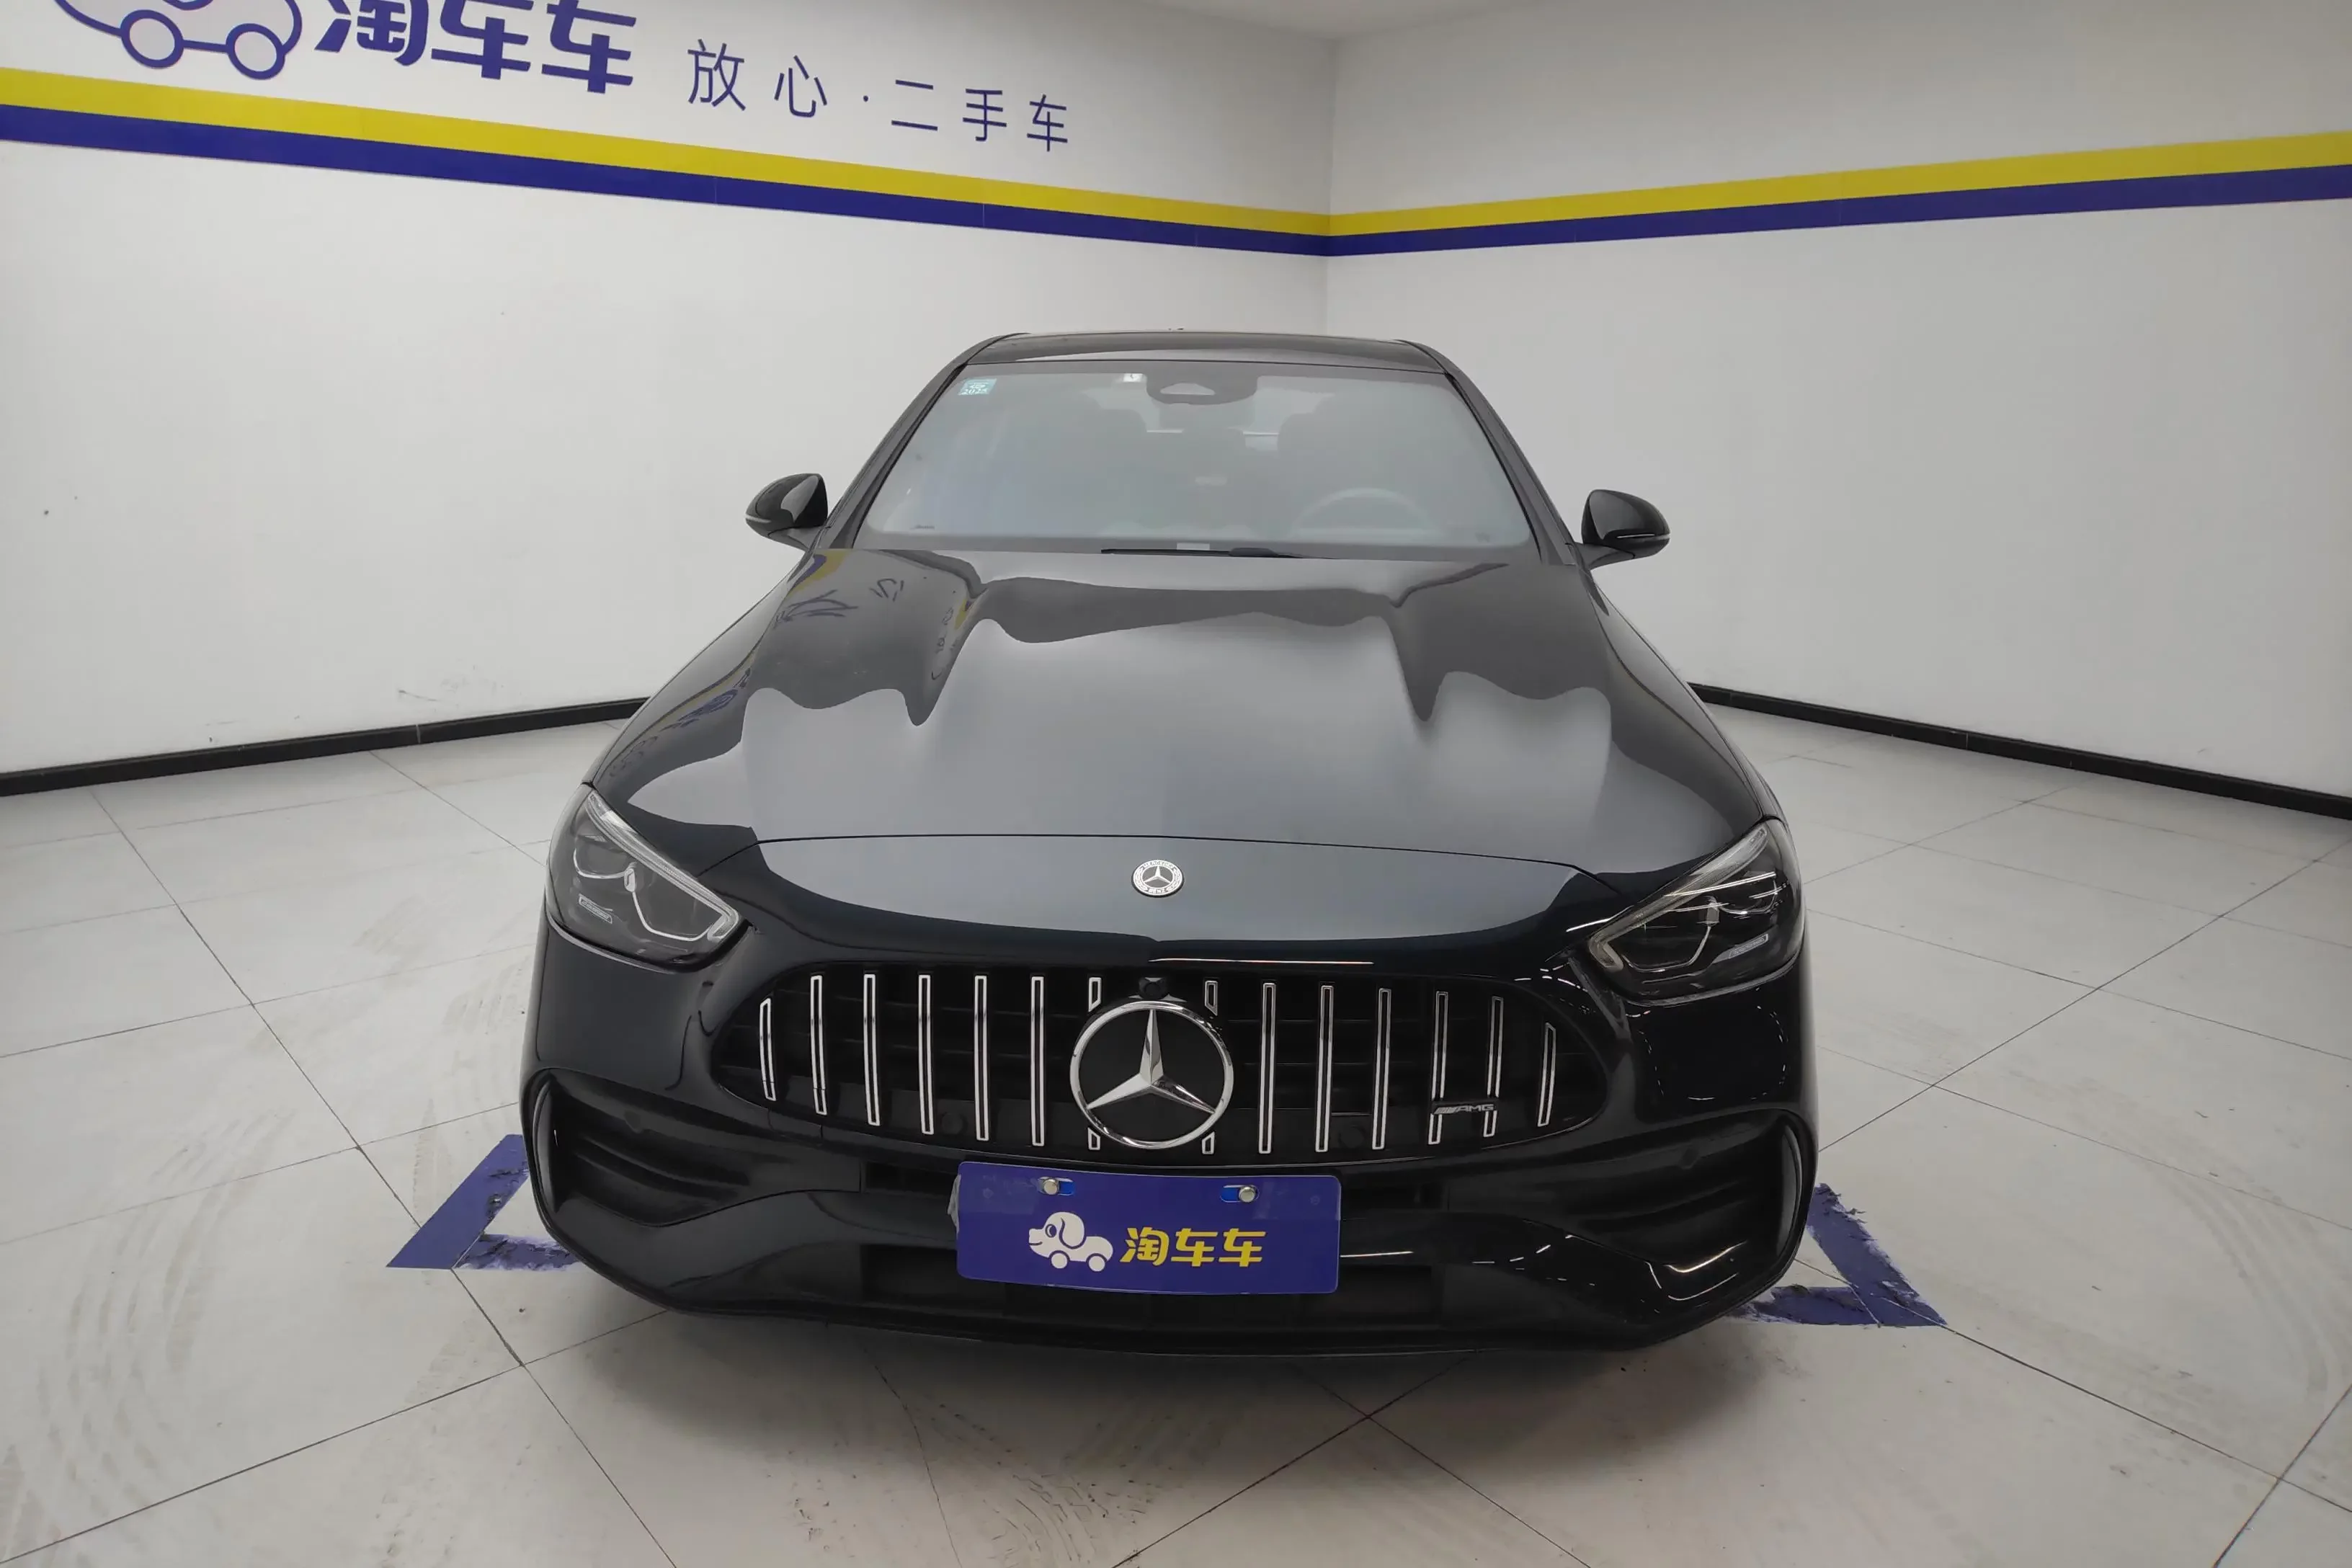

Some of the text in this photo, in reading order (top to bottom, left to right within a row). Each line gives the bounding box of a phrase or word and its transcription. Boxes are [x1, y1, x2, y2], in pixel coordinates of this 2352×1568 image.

[314, 0, 637, 94] 淘车车
[1447, 1104, 1494, 1113] AMG
[1120, 1227, 1266, 1267] 淘车车
